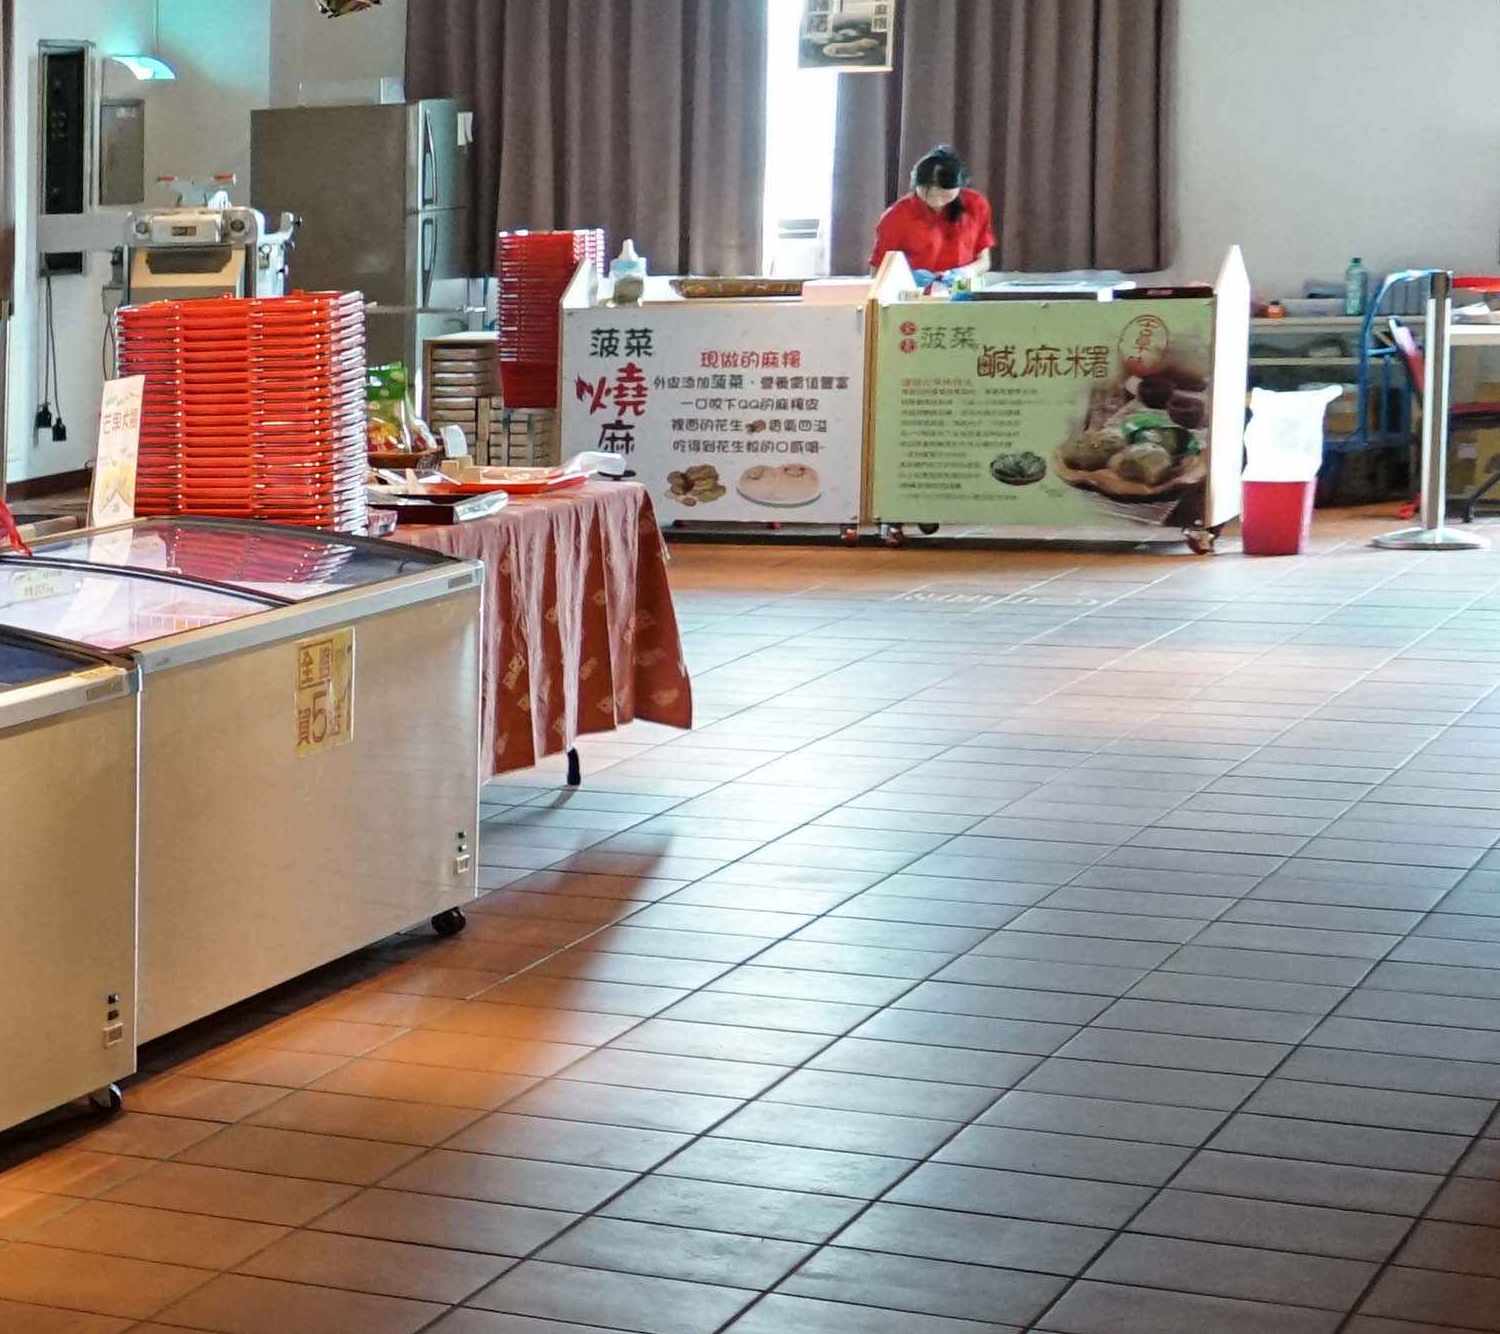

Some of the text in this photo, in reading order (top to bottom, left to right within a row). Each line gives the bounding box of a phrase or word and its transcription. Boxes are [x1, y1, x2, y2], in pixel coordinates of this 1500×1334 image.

[589, 327, 654, 358] 菠菜
[919, 326, 980, 351] 菠菜
[700, 349, 802, 369] 現做的麻糬
[975, 344, 1110, 379] 鹹麻糬
[574, 362, 649, 481] 燒麻
